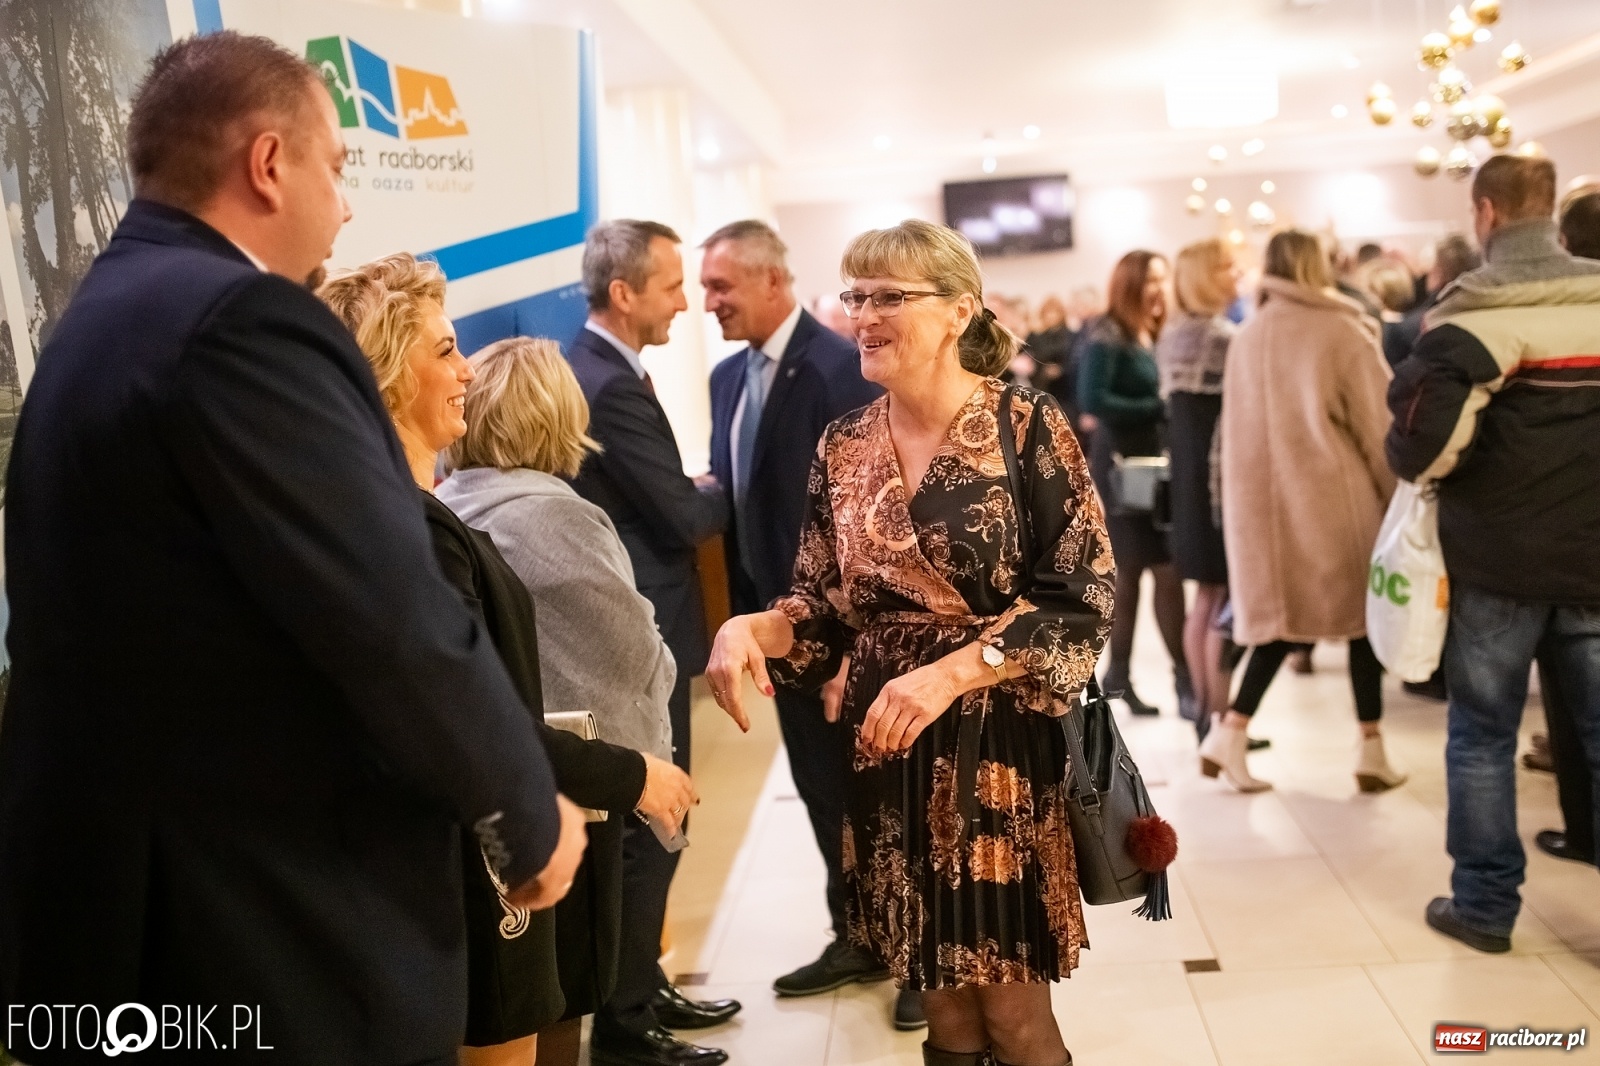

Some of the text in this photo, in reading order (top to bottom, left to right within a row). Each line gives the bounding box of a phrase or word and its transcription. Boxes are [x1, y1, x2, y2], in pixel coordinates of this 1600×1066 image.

[345, 146, 474, 172] at raciborski
[372, 177, 414, 191] oaza
[425, 177, 474, 193] kultur
